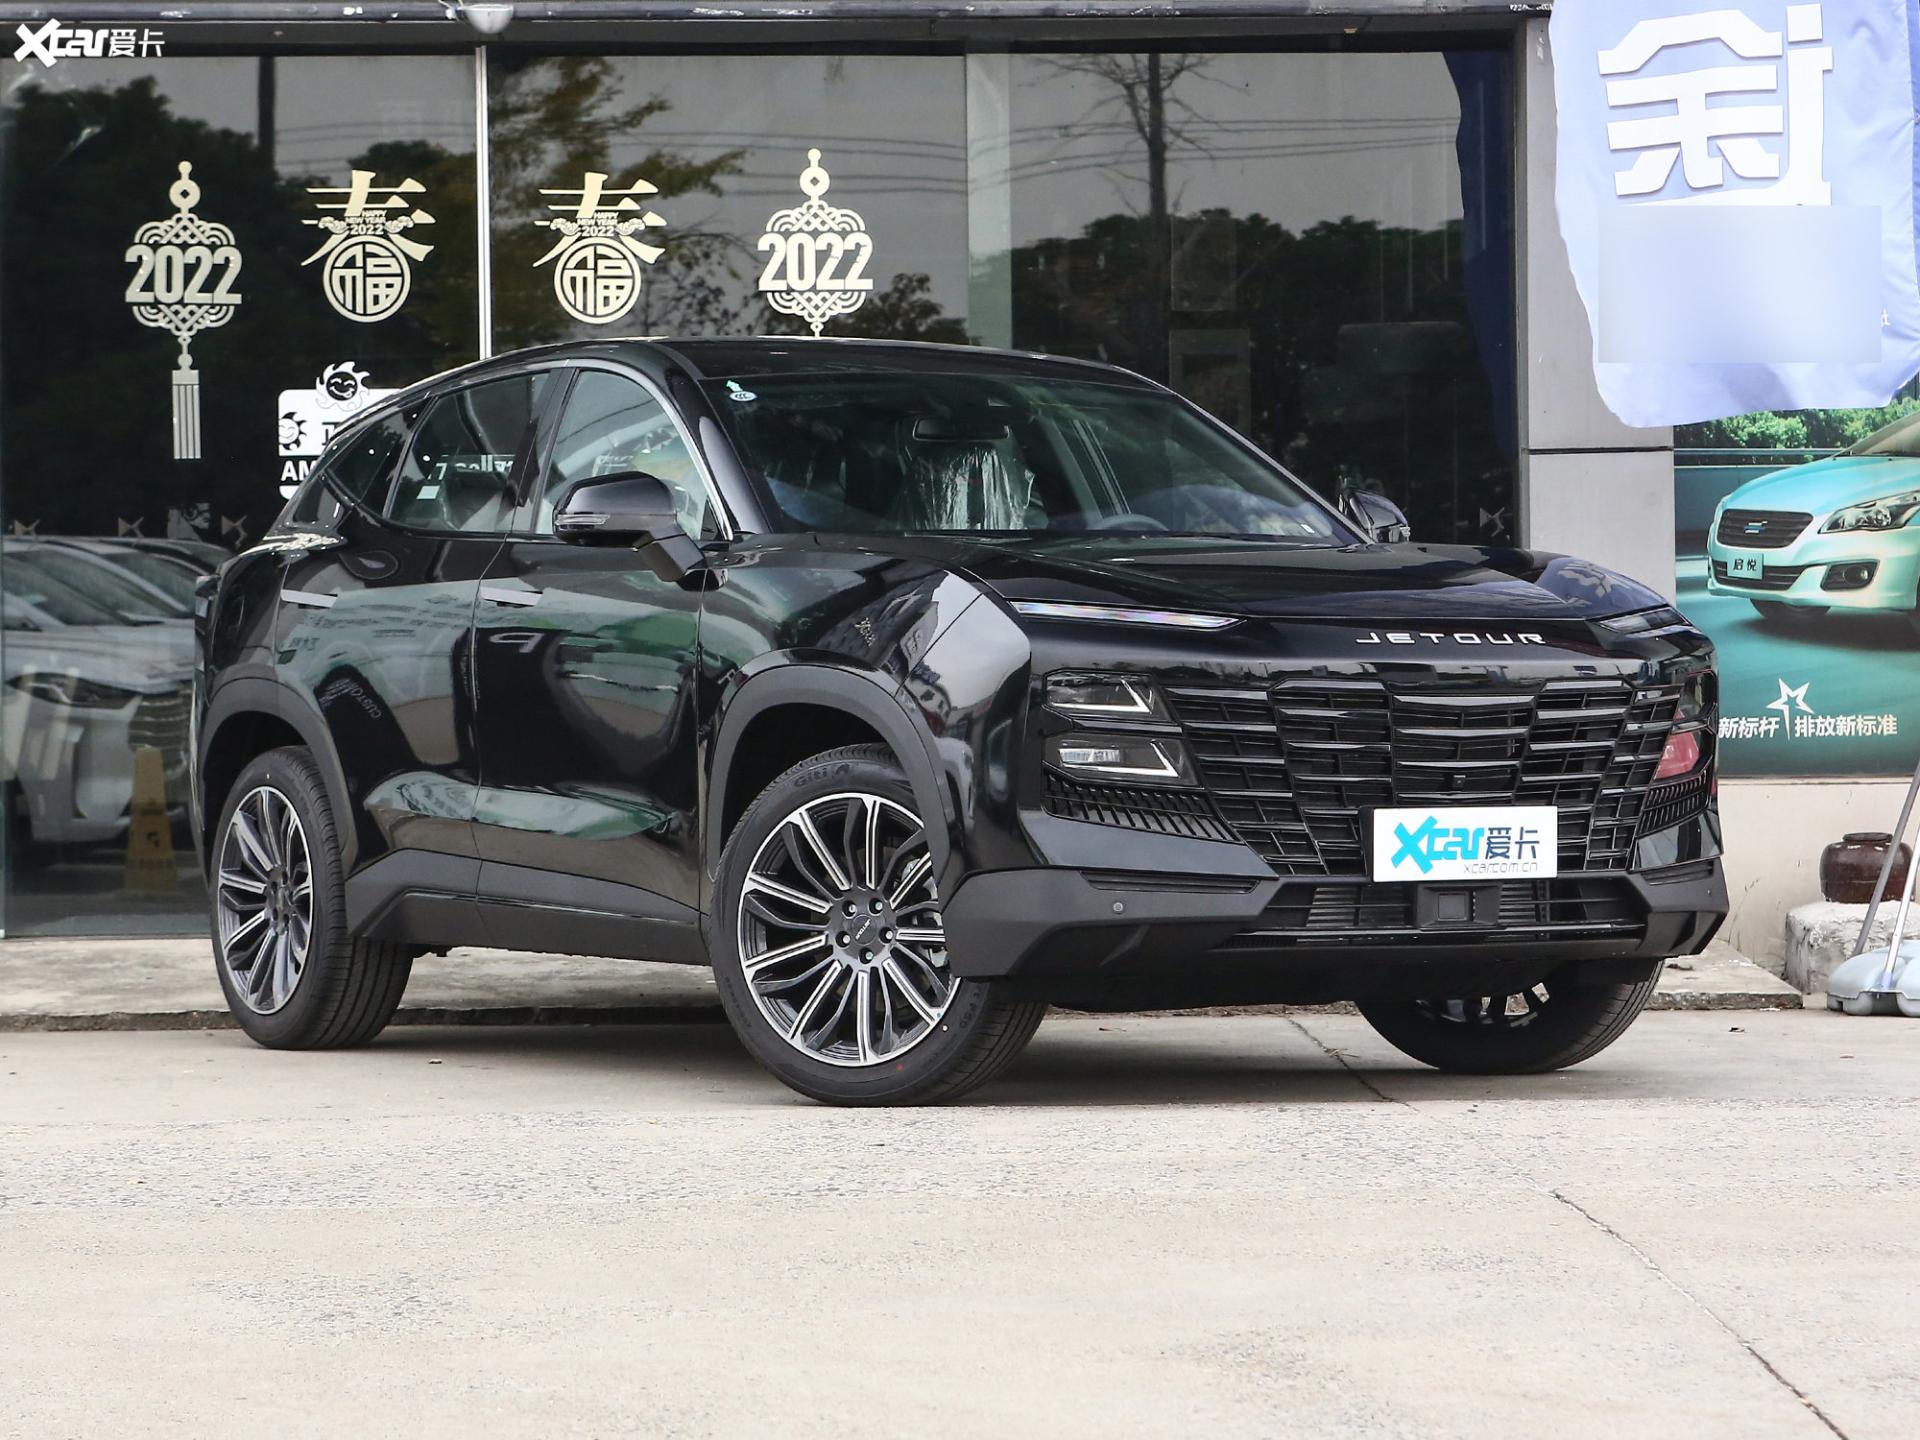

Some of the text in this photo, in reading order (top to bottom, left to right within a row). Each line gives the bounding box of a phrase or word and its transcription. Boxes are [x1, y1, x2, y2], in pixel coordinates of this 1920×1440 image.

[301, 169, 437, 267] 春
[350, 224, 384, 235] 2022
[532, 171, 668, 267] 春
[581, 226, 615, 237] 2022
[125, 244, 242, 304] 2022
[329, 241, 405, 317] 福
[559, 242, 637, 319] 福
[758, 232, 873, 291] 2022
[1356, 632, 1546, 644] JETOUR
[1719, 714, 1898, 739] 新标杆 排放新标准
